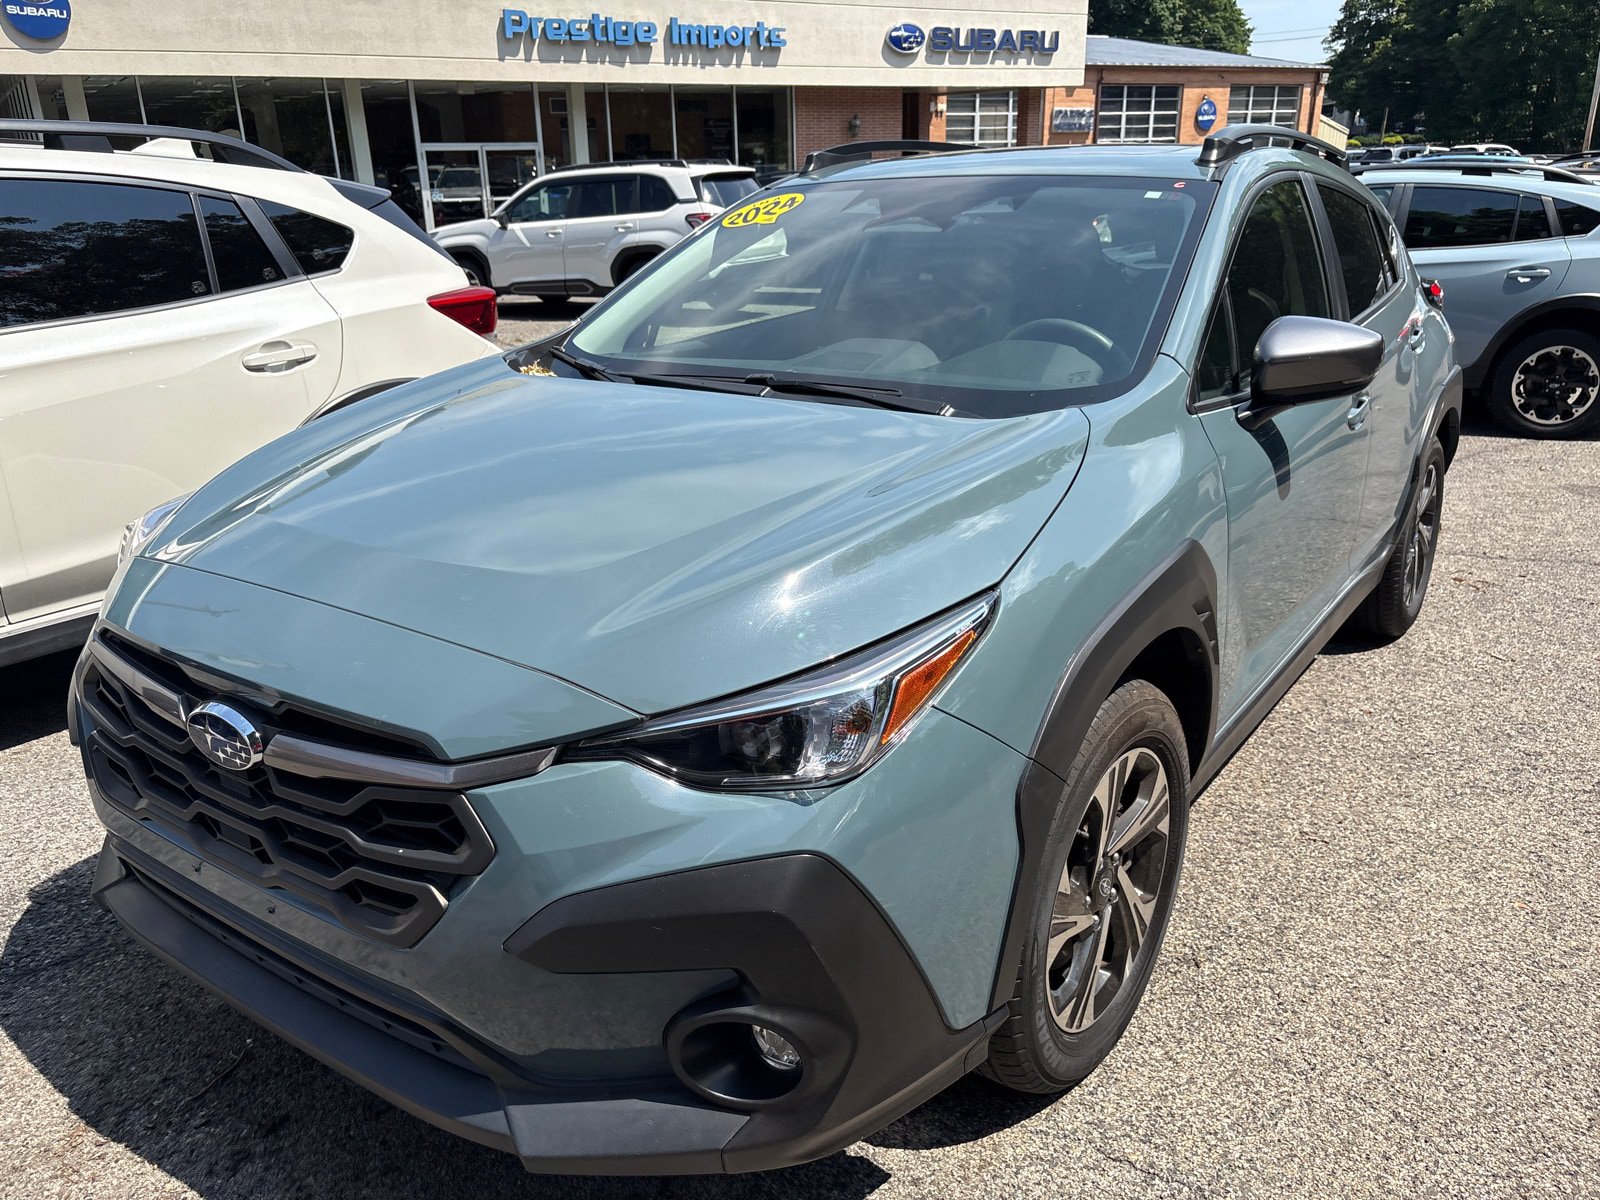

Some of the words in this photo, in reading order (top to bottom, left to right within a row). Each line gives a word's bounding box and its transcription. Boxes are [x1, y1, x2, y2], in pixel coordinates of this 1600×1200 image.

[6, 5, 67, 19] SUBARU
[502, 9, 658, 46] Prestige
[668, 17, 787, 49] Imports
[931, 26, 1059, 54] SUBARU
[727, 196, 799, 225] 2024
